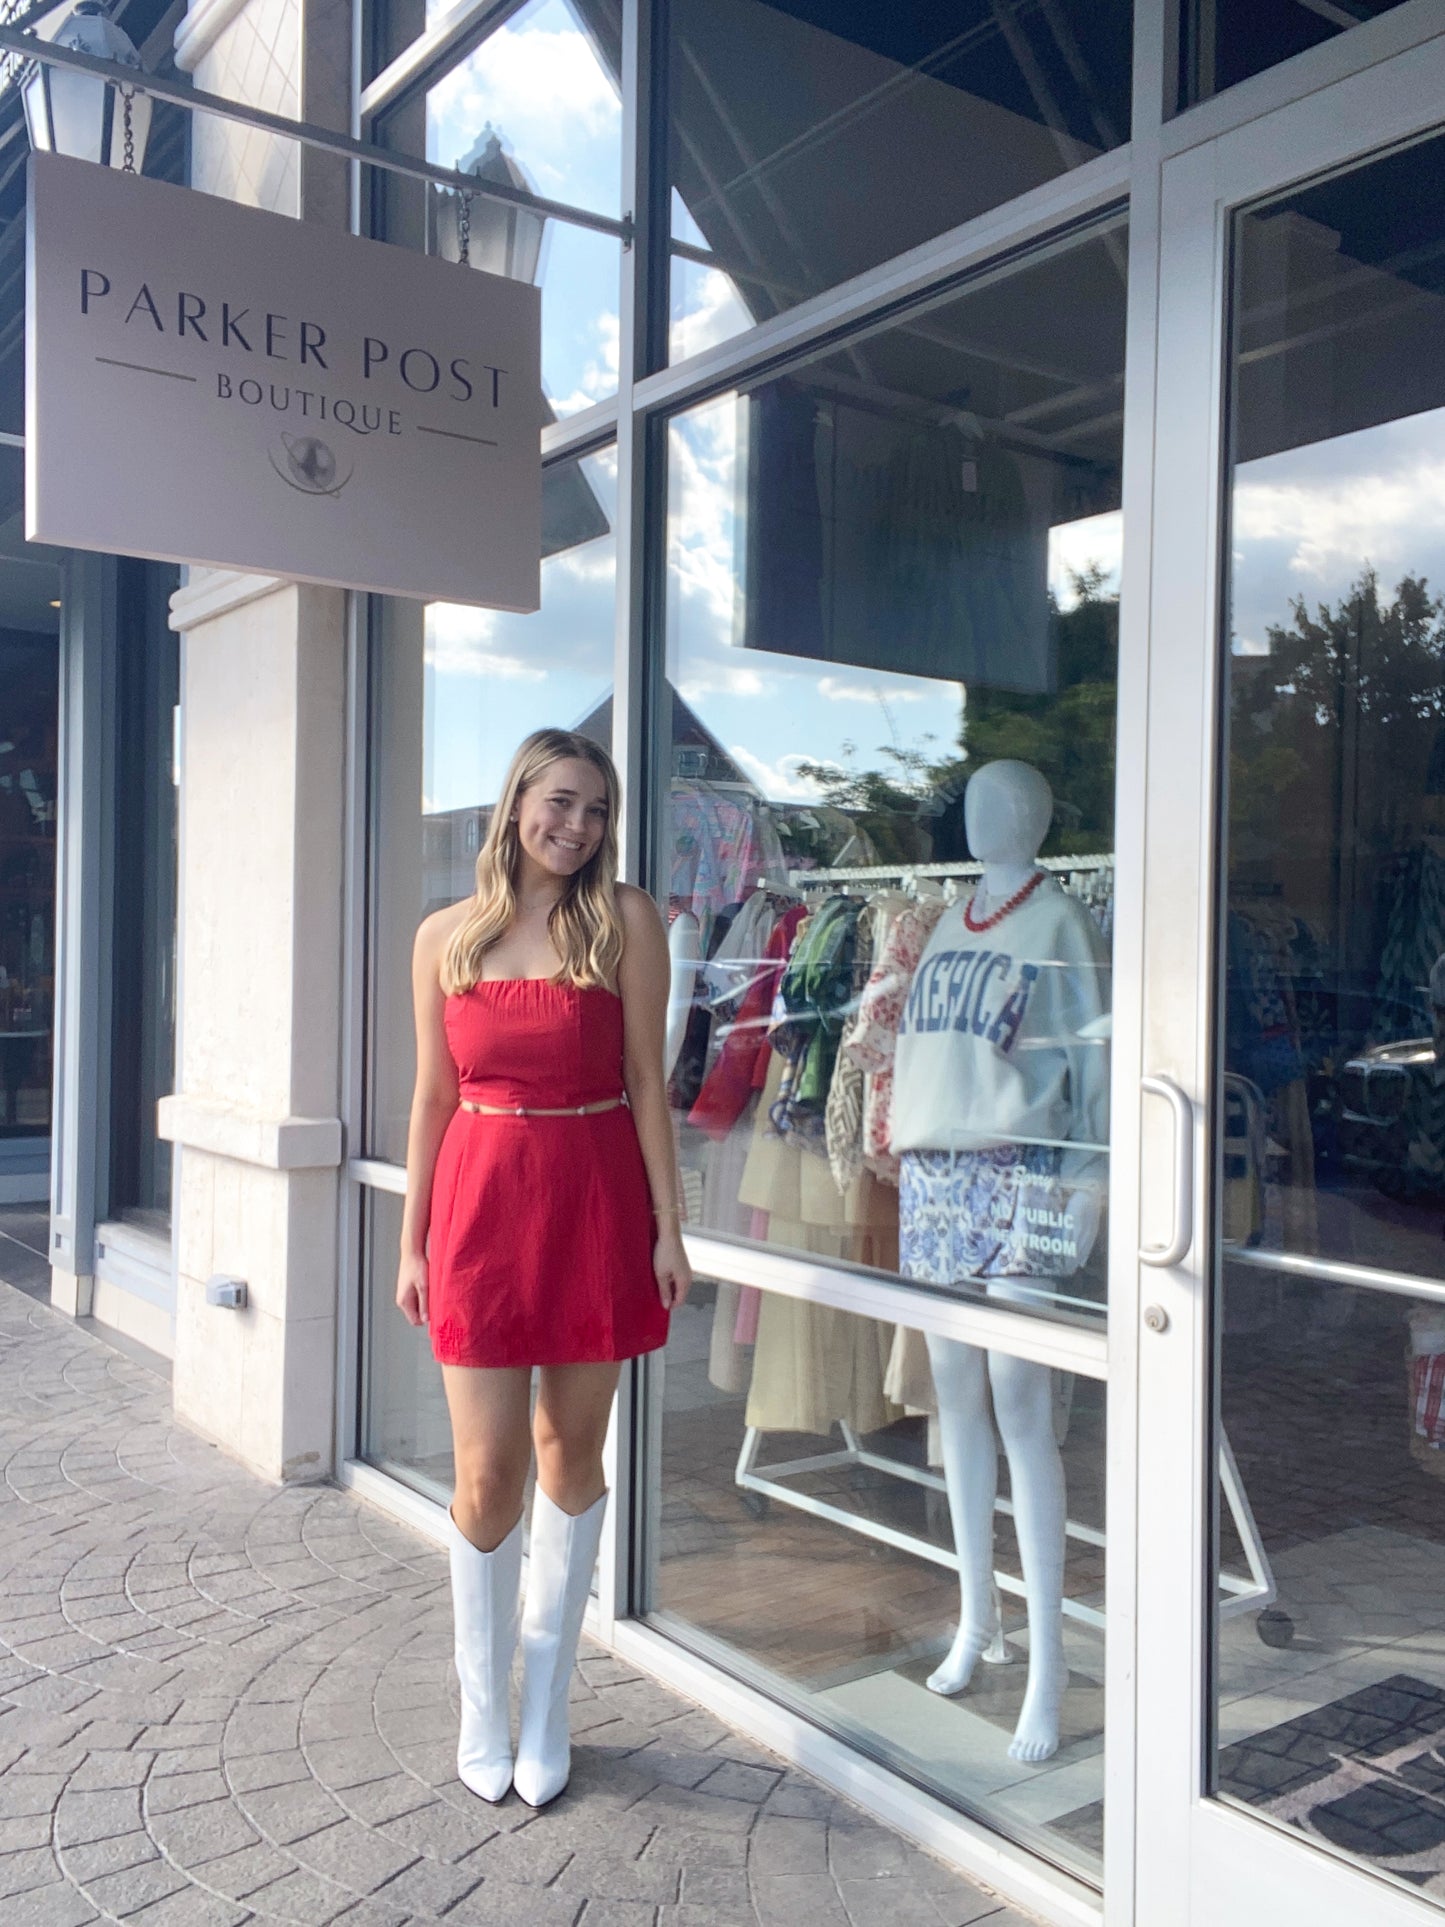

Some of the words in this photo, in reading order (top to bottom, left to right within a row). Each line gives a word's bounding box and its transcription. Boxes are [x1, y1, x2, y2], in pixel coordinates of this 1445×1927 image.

[80, 269, 329, 369] PARKER
[364, 337, 509, 408] POST
[217, 373, 402, 435] BOUTIQUE
[899, 951, 1038, 1053] MERICA
